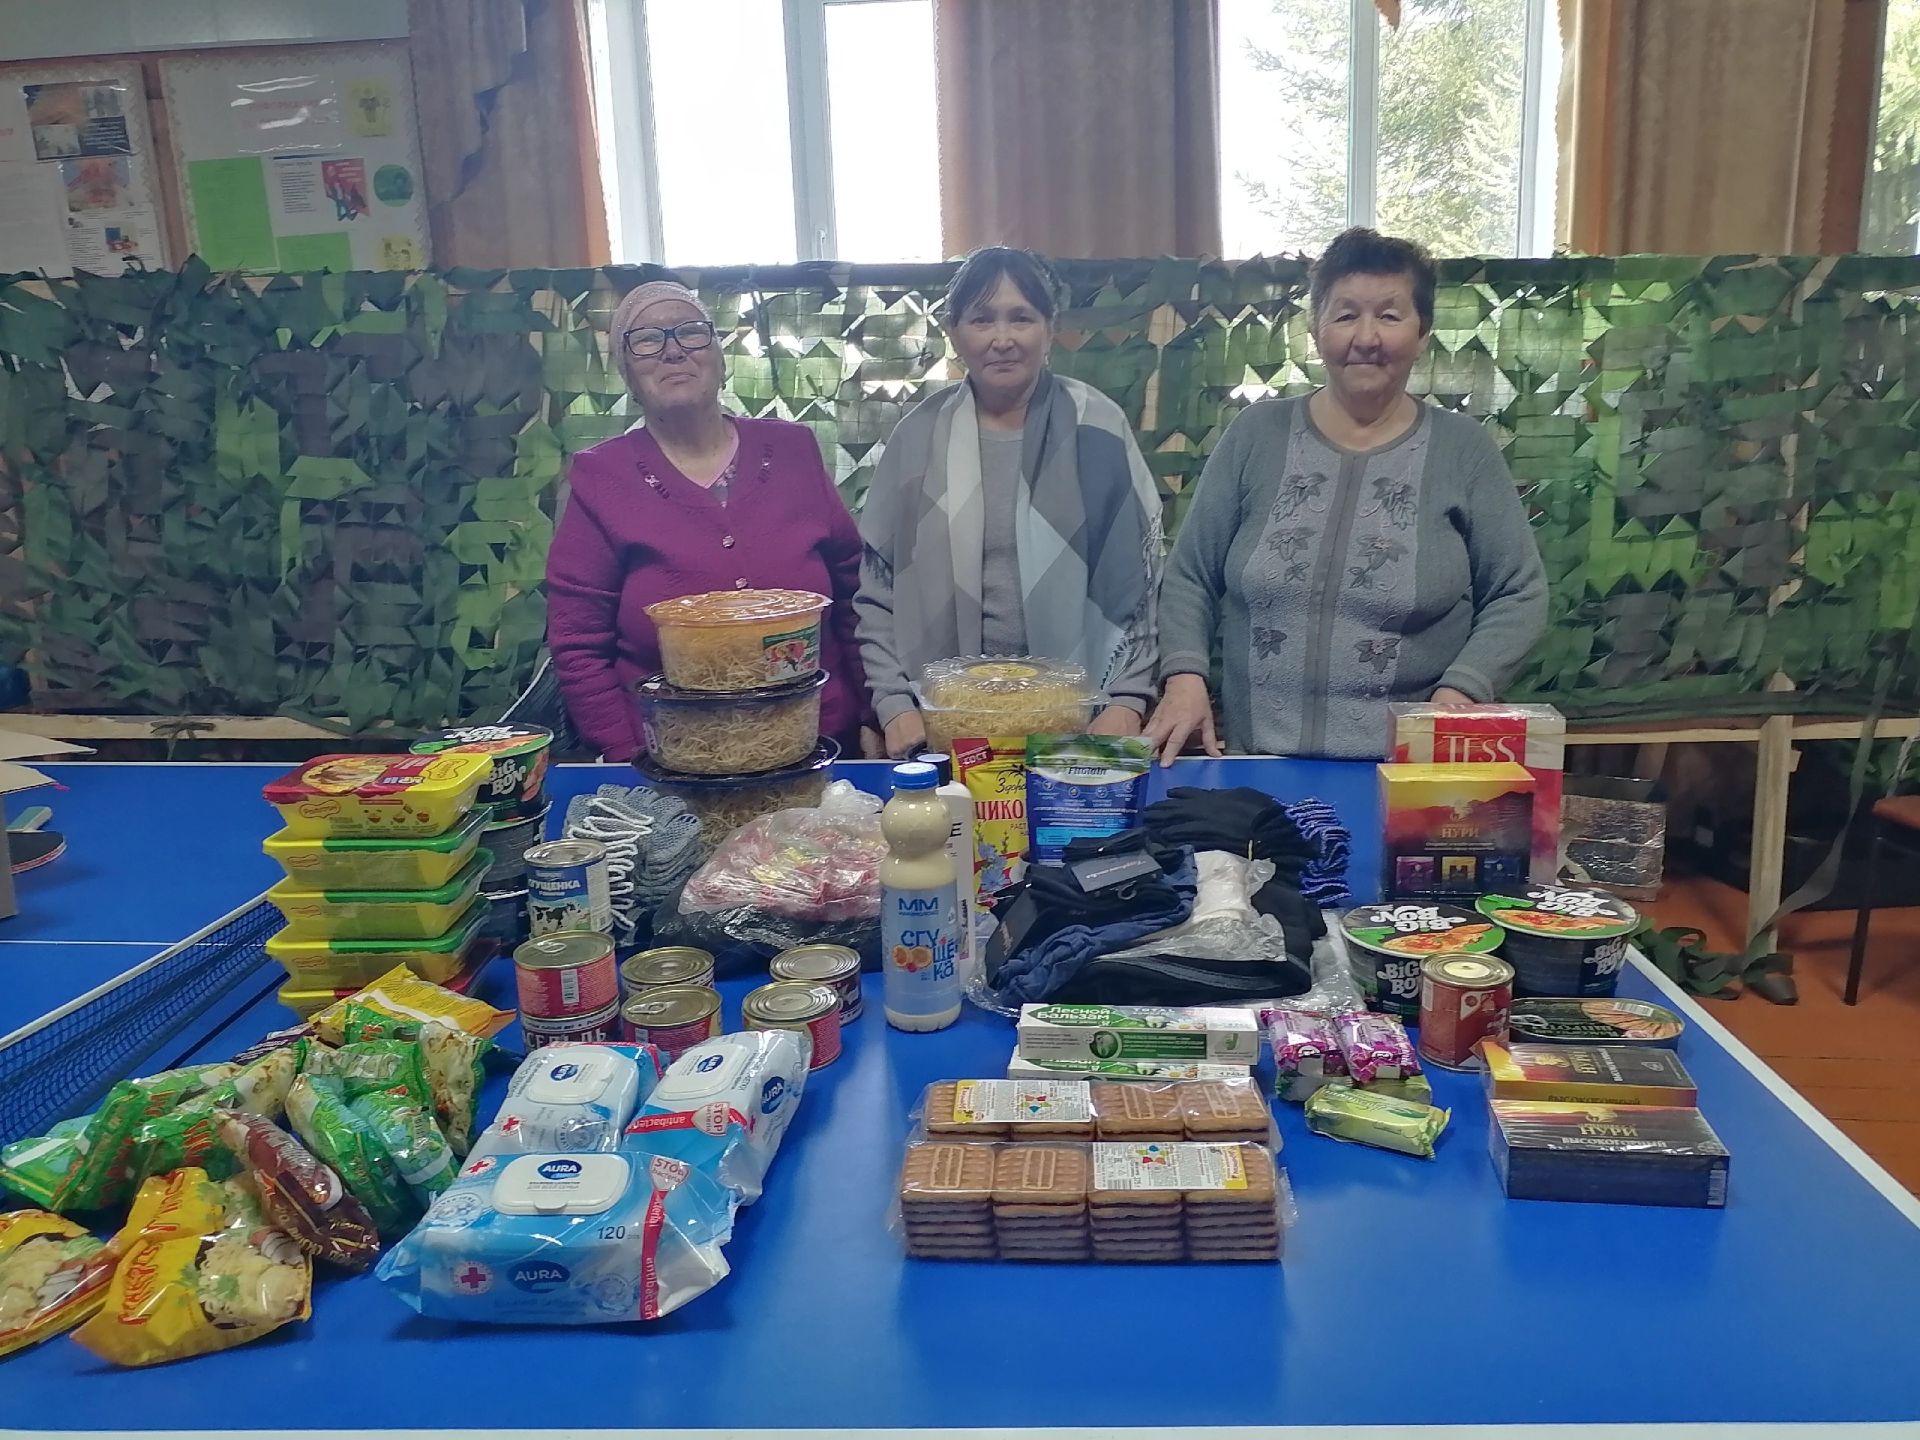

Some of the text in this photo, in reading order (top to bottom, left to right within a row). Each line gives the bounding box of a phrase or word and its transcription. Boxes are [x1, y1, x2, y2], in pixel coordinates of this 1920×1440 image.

[1442, 735, 1517, 762] TESS
[1441, 827, 1479, 838] НУРИ
[1390, 977, 1420, 998] BO
[1037, 1012, 1110, 1020] Бальзам
[1049, 1007, 1111, 1015] Лесной
[713, 1104, 723, 1132] STOP
[1580, 1126, 1638, 1137] НУРИ
[1561, 1138, 1667, 1148] ВЫСОКОГОРНЫЙ
[542, 1164, 578, 1173] AURA
[598, 1226, 626, 1239] 120
[514, 1269, 563, 1282] AURA
